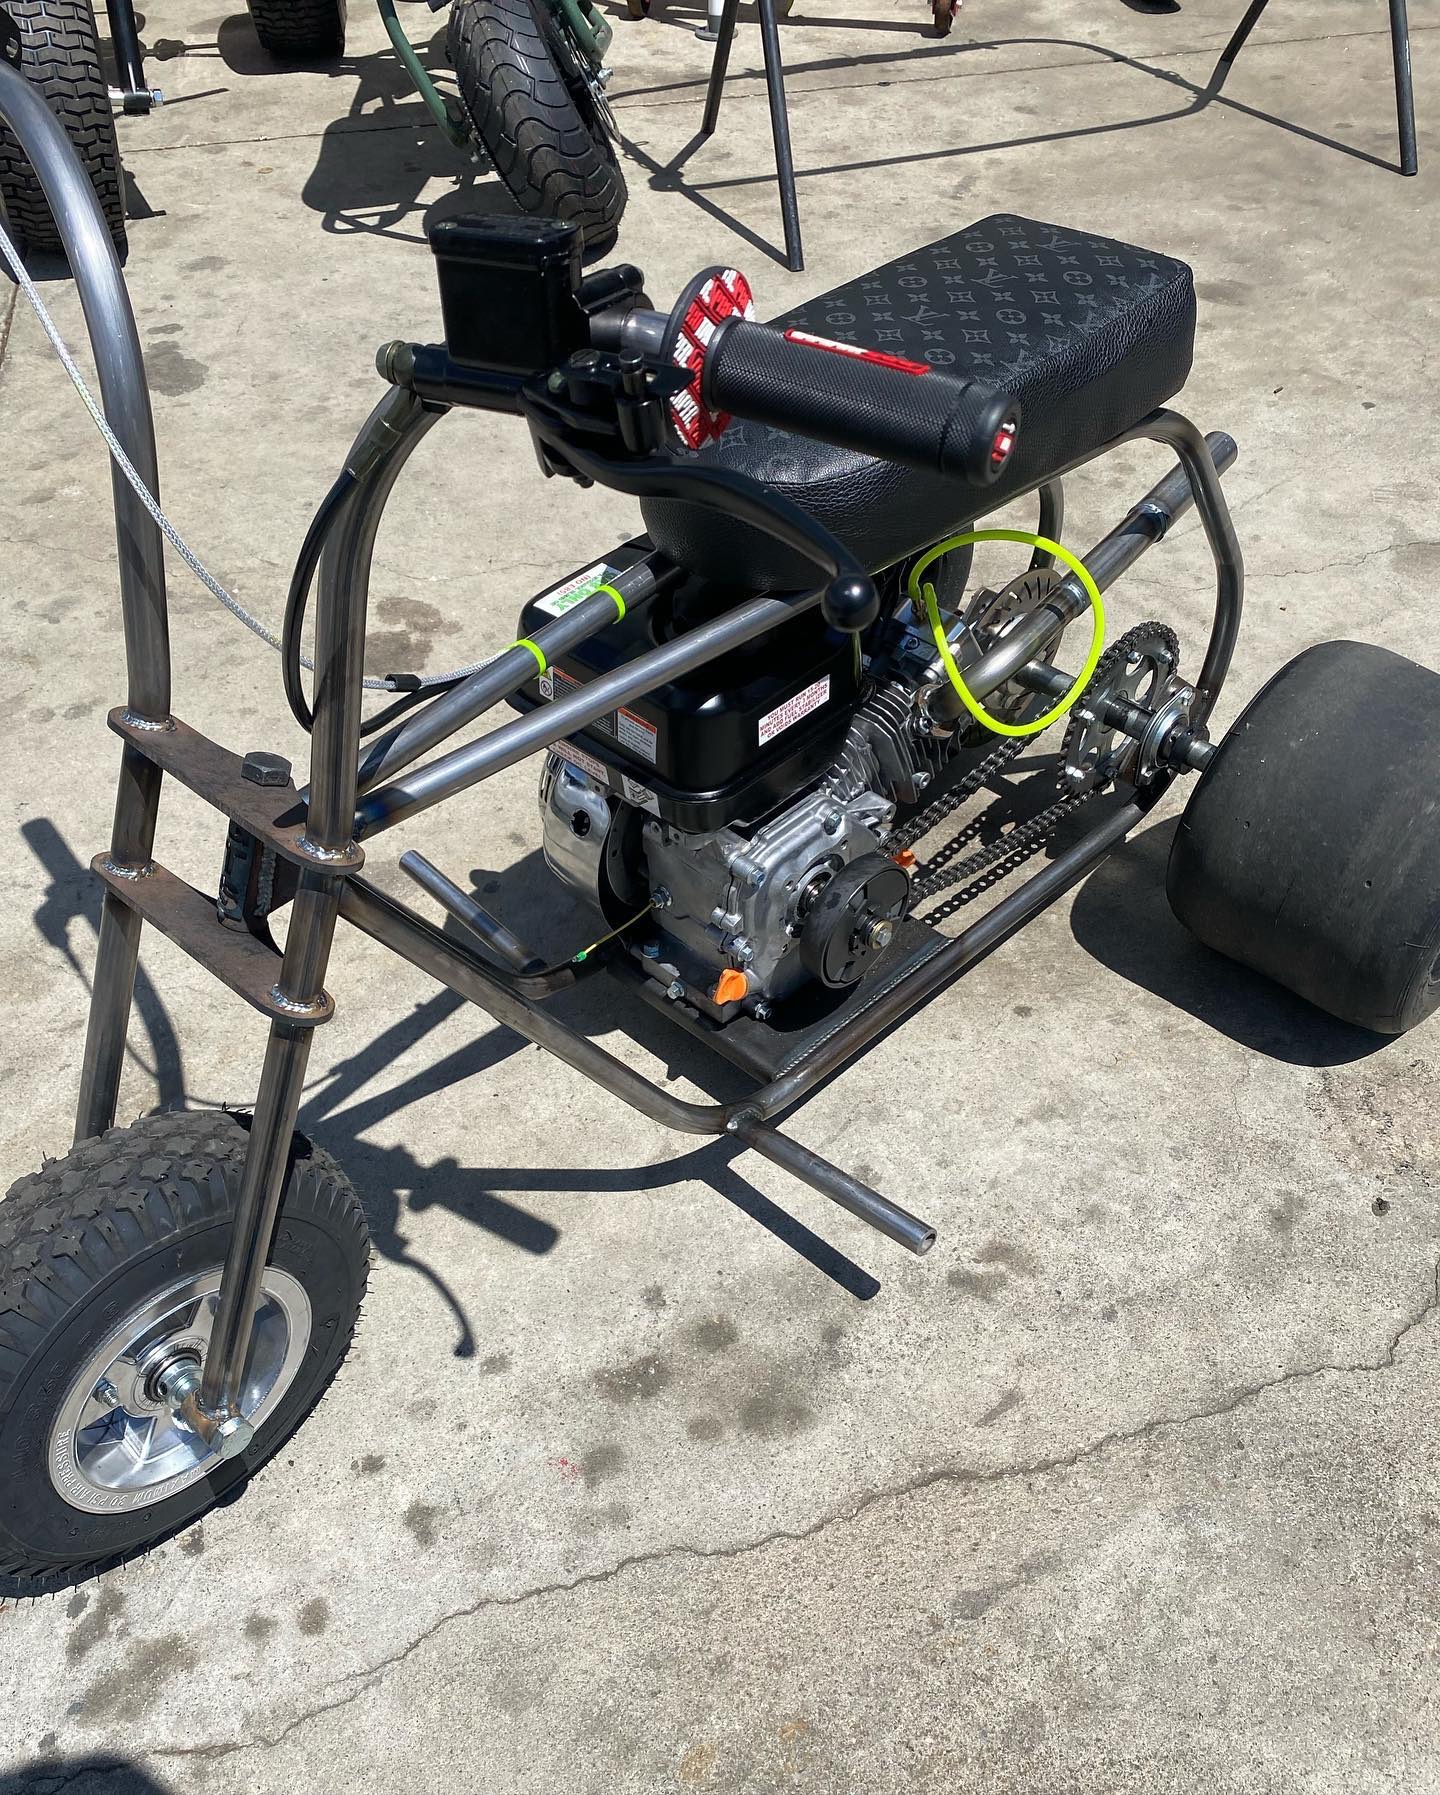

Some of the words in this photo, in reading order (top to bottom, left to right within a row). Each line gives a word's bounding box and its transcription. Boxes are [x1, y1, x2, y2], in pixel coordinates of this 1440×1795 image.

[760, 712, 782, 731] MINUTES
[784, 700, 800, 715] EVERY
[806, 682, 827, 700] MONTHS
[767, 709, 778, 720] YOU
[779, 698, 793, 712] MUST
[792, 699, 819, 721] WARRANTY
[761, 726, 770, 737] AND
[773, 717, 782, 728] ADD
[784, 708, 797, 721] FUEL
[55, 1428, 77, 1488] PRESSURE
[70, 1482, 90, 1501] AIR
[132, 1466, 201, 1504] MAXIMUM
[87, 1492, 109, 1506] PSI
[110, 1494, 128, 1507] 30
